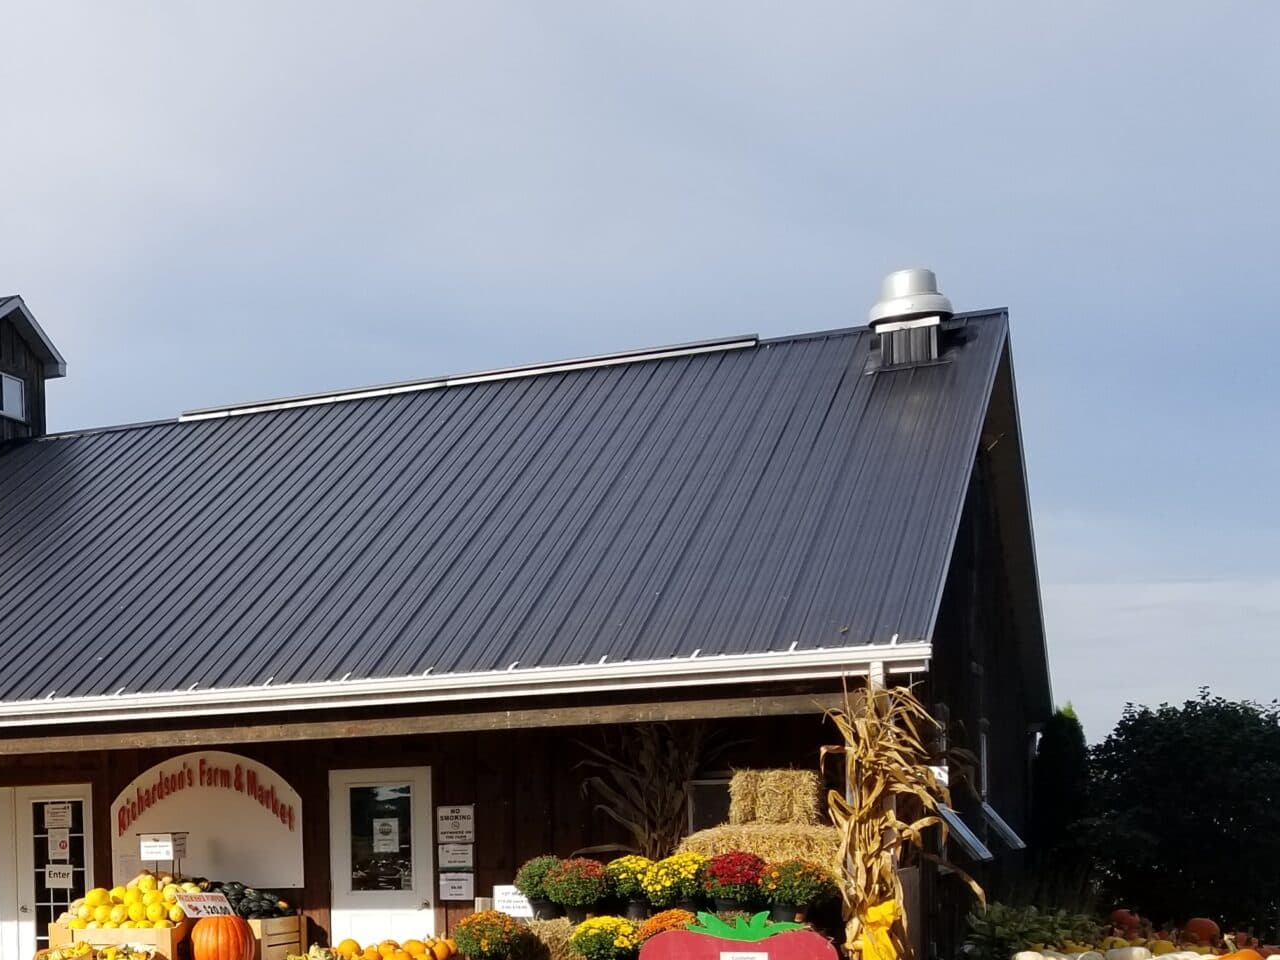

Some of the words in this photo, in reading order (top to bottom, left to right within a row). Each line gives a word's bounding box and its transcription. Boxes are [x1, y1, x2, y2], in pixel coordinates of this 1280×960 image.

[118, 761, 194, 837] Richardson's
[199, 758, 231, 789] Farm
[234, 764, 244, 793] &
[247, 769, 296, 832] Market
[439, 814, 472, 822] SMOKING
[48, 870, 71, 880] Enter
